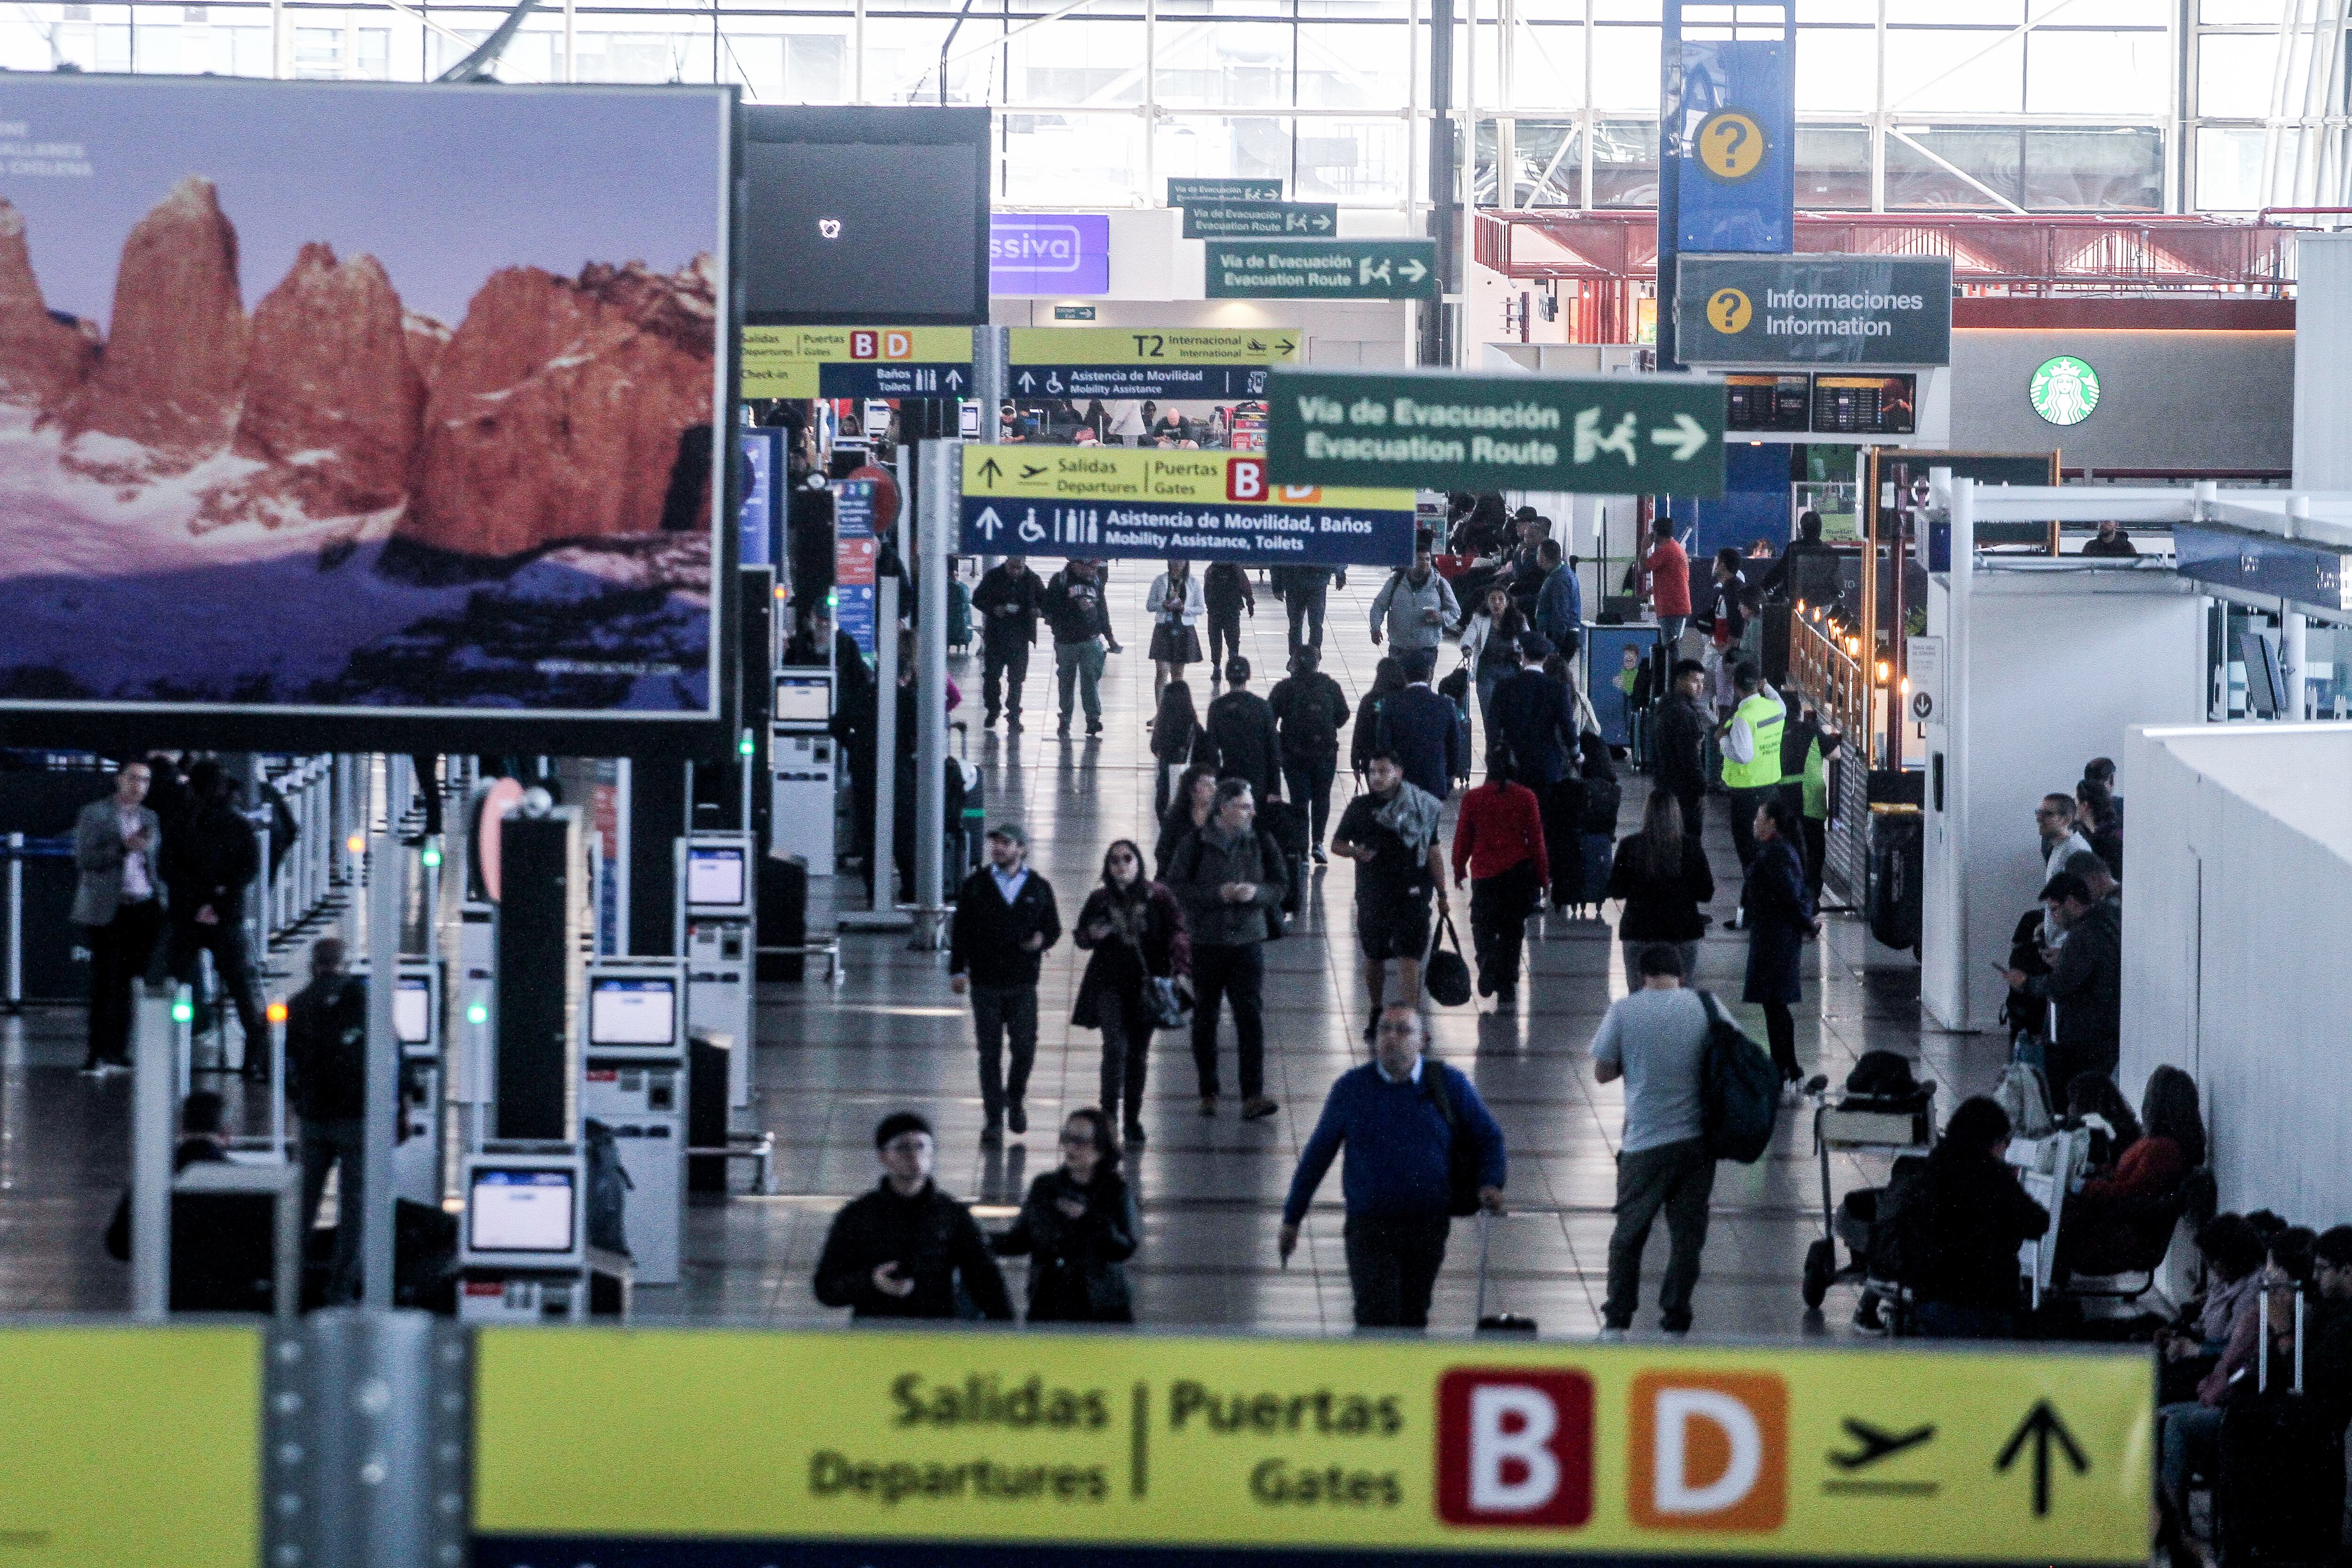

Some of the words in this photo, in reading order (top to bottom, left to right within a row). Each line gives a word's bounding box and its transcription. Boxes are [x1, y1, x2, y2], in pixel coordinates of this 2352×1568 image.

[1211, 209, 1224, 218] de
[1196, 220, 1249, 231] Evacuation
[1251, 222, 1281, 231] Route
[1246, 255, 1265, 268] de
[1224, 273, 1304, 286] Evacuation
[1308, 273, 1352, 287] Route
[1767, 289, 1923, 310] Informaciones
[1767, 316, 1891, 337] Information
[856, 334, 873, 356] B
[888, 334, 908, 356] D
[1133, 334, 1164, 357] T2
[1168, 336, 1241, 345] Internacional
[1070, 371, 1127, 382] Asistencia
[1130, 371, 1144, 382] de
[1147, 370, 1203, 382] Movilidad
[1070, 385, 1110, 396] Mobility
[1112, 385, 1162, 394] Assistance
[1349, 398, 1385, 424] de
[1393, 399, 1560, 429] Evacuación
[1305, 432, 1464, 462] Evacuation
[1470, 435, 1557, 465] Route
[1057, 479, 1138, 496] Departures
[1154, 482, 1195, 494] Gates
[1058, 458, 1117, 473] Salidas
[1155, 460, 1217, 476] Puertas
[1235, 462, 1260, 498] B
[1106, 510, 1193, 527] Asistencia
[1198, 512, 1220, 528] de
[1224, 513, 1315, 532] Movilidad,
[1320, 516, 1372, 533] Baños
[1105, 531, 1167, 549] Mobility
[1255, 535, 1304, 549] Toilets
[890, 1372, 1108, 1429] Salidas
[1169, 1378, 1403, 1436] Puertas
[1469, 1384, 1561, 1512] B
[1654, 1388, 1761, 1513] D
[809, 1449, 1106, 1503] Departures
[1249, 1458, 1401, 1506] Gates
